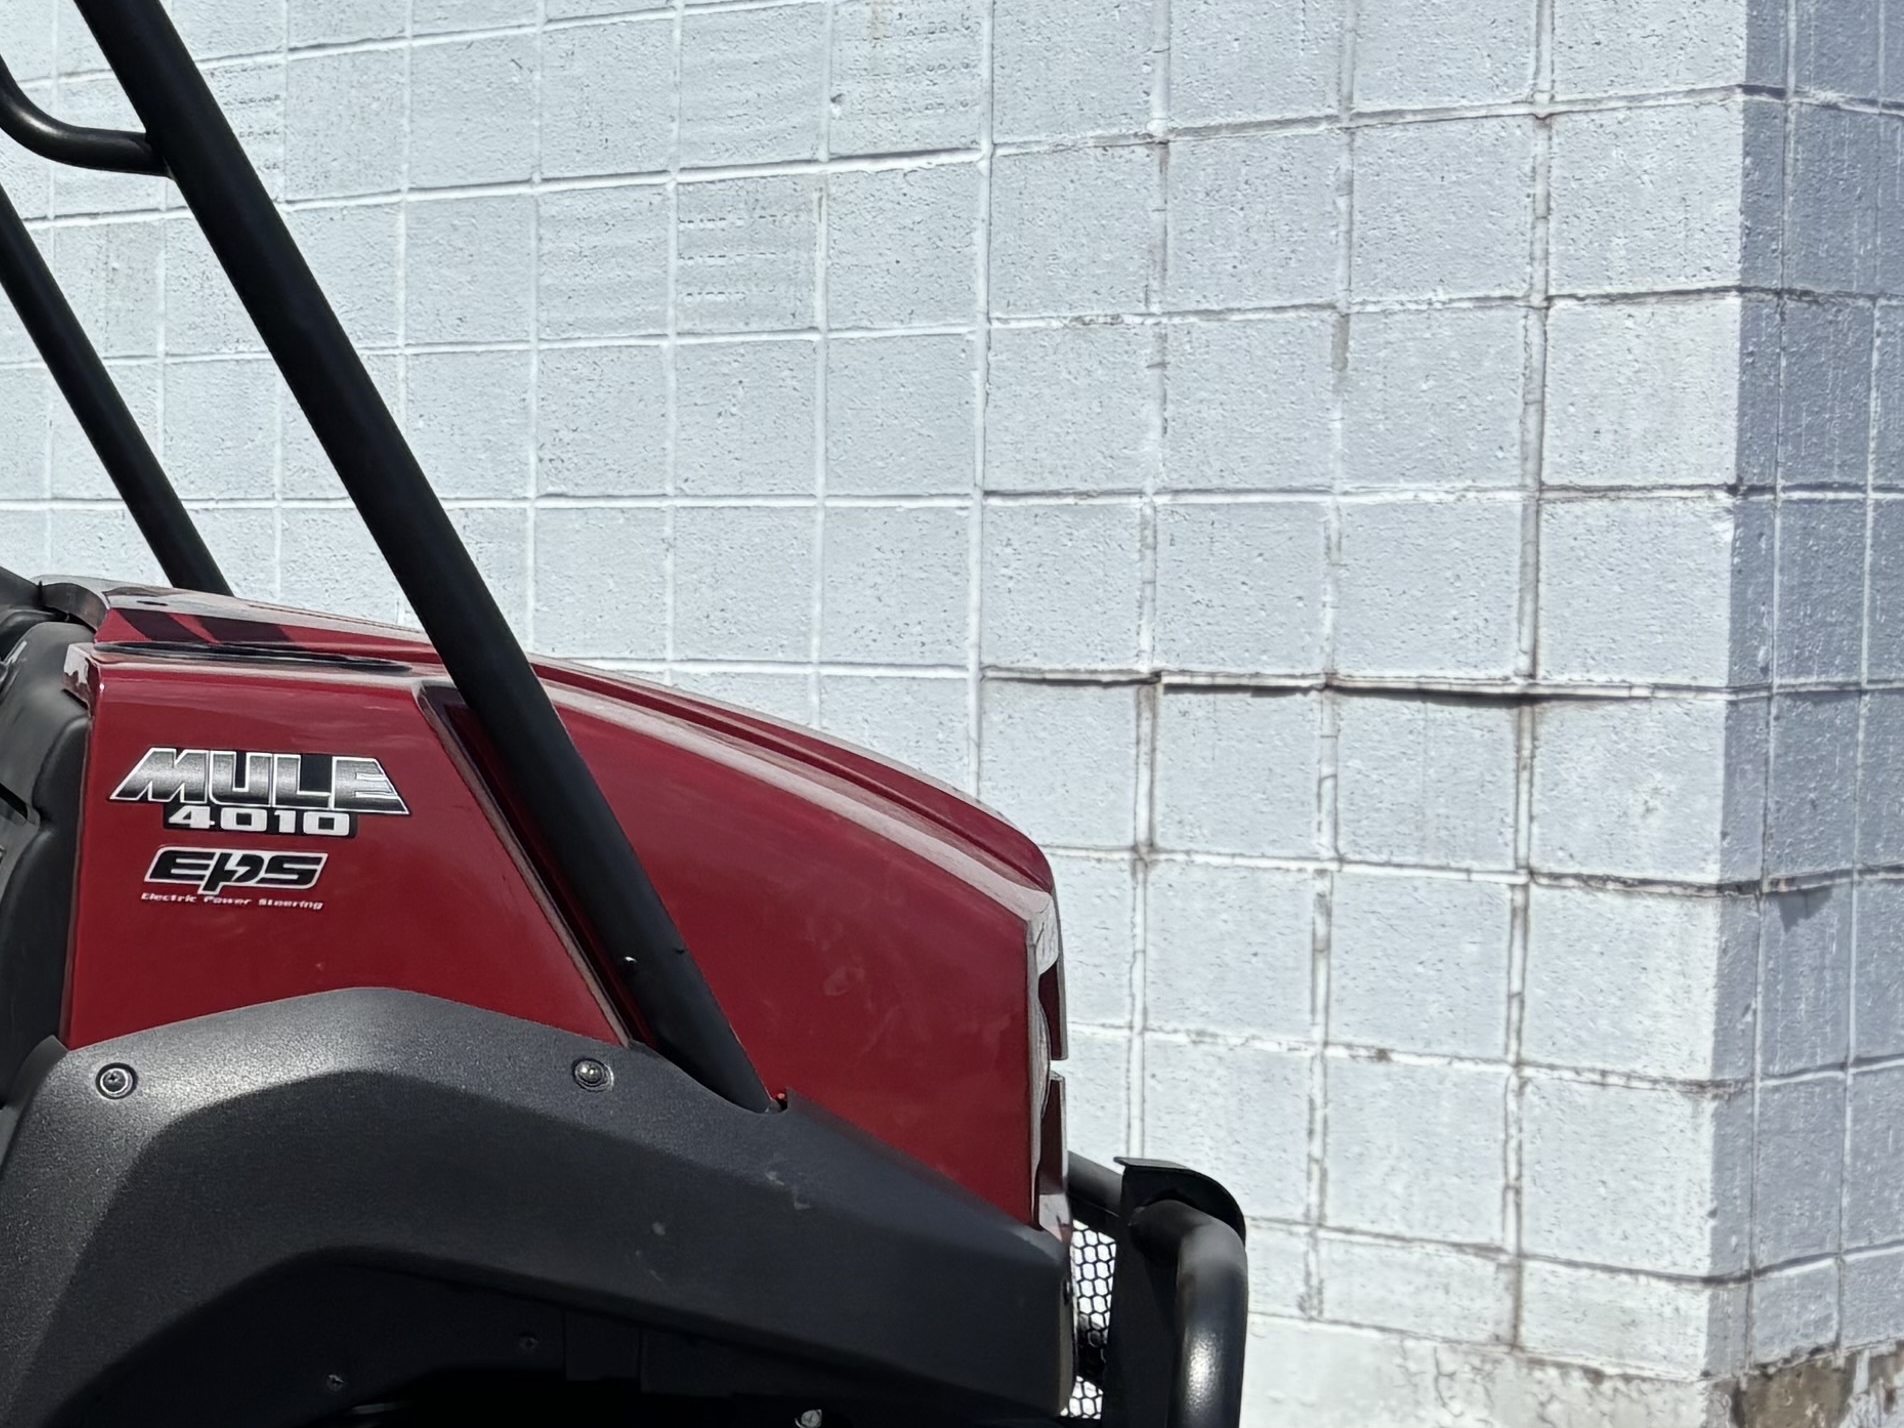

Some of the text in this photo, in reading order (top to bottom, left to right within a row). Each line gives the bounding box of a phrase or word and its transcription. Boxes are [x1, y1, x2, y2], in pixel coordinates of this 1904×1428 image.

[108, 747, 411, 815] MULE
[168, 805, 351, 836] 4010
[144, 846, 328, 895] EPS
[140, 892, 324, 910] Electric Power Steering
